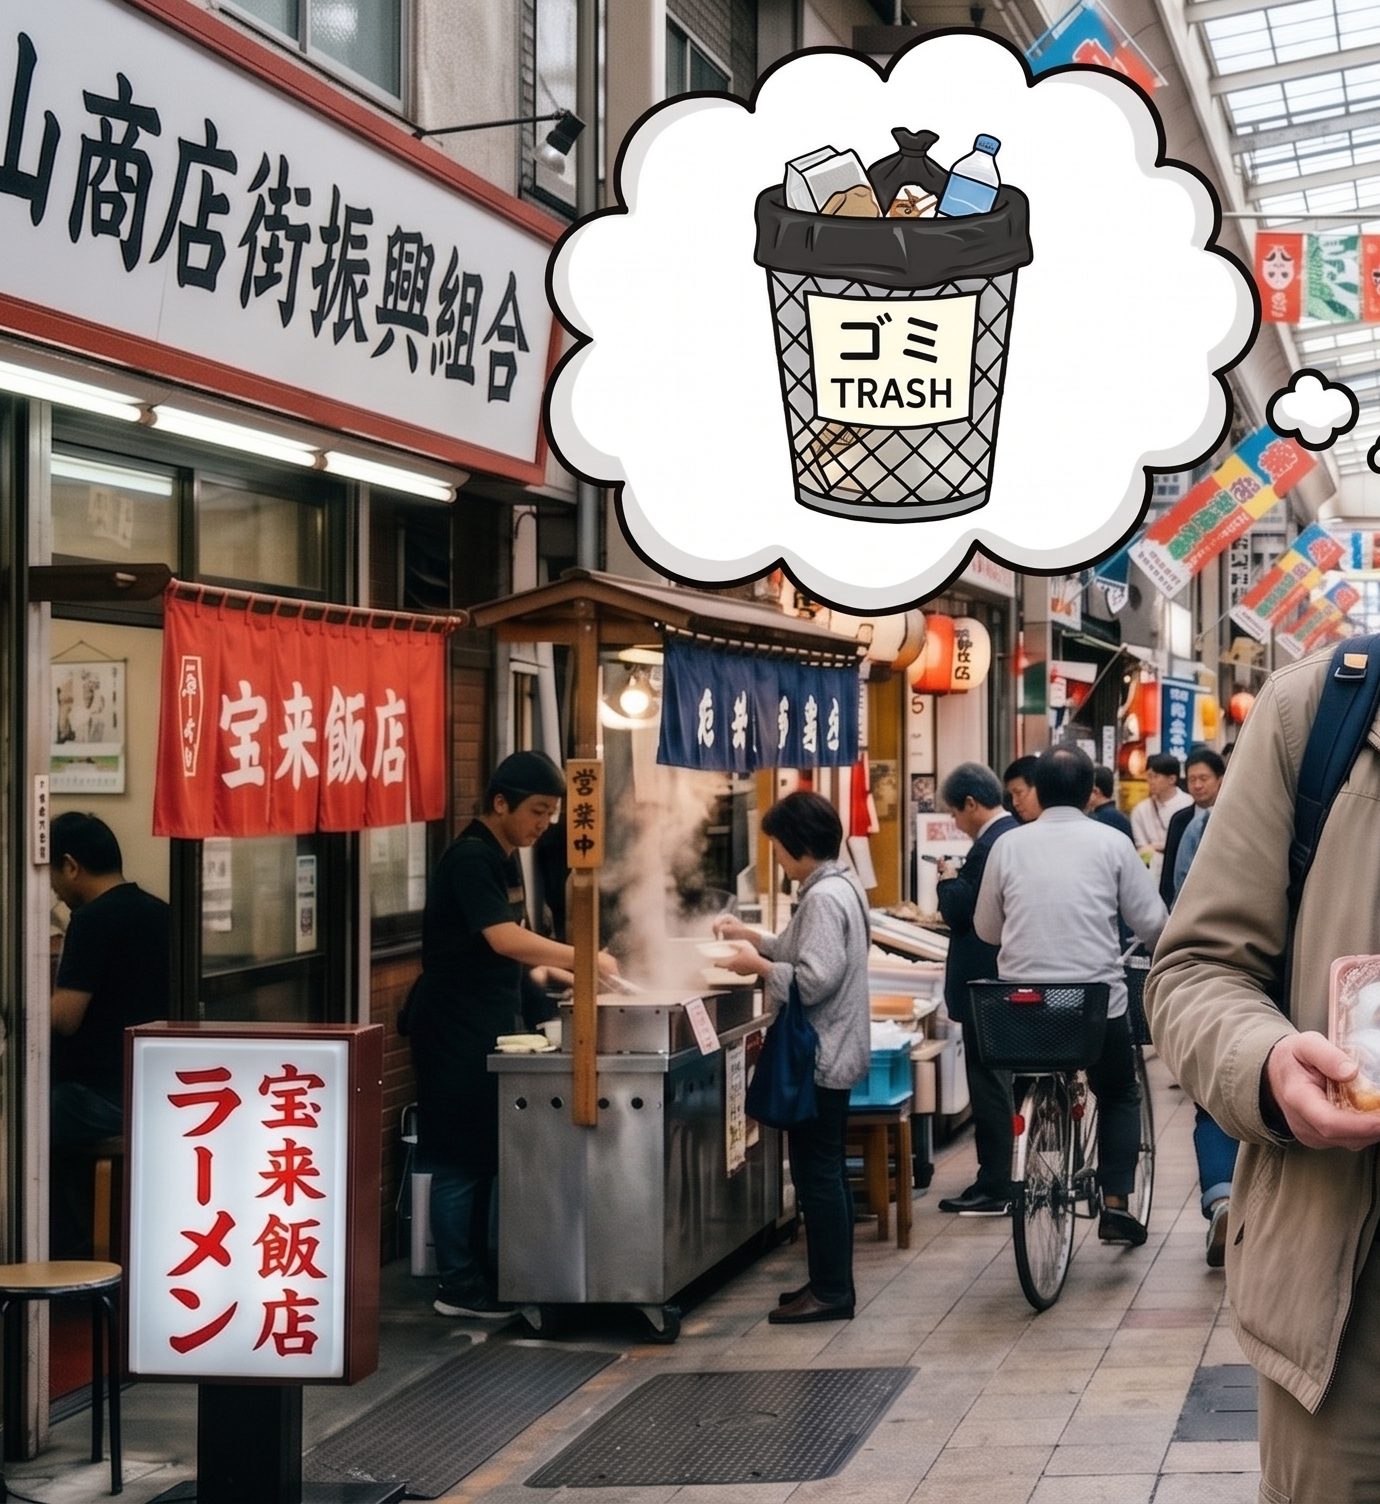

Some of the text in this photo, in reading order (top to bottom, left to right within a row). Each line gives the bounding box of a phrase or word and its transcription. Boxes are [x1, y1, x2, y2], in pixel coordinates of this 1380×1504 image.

[0, 32, 530, 404] 山商店街振興組合
[219, 680, 407, 791] 宝来飯店
[572, 768, 597, 859] 営業中
[166, 1066, 243, 1355] ラーメン
[252, 1063, 328, 1358] 宝来飯店
